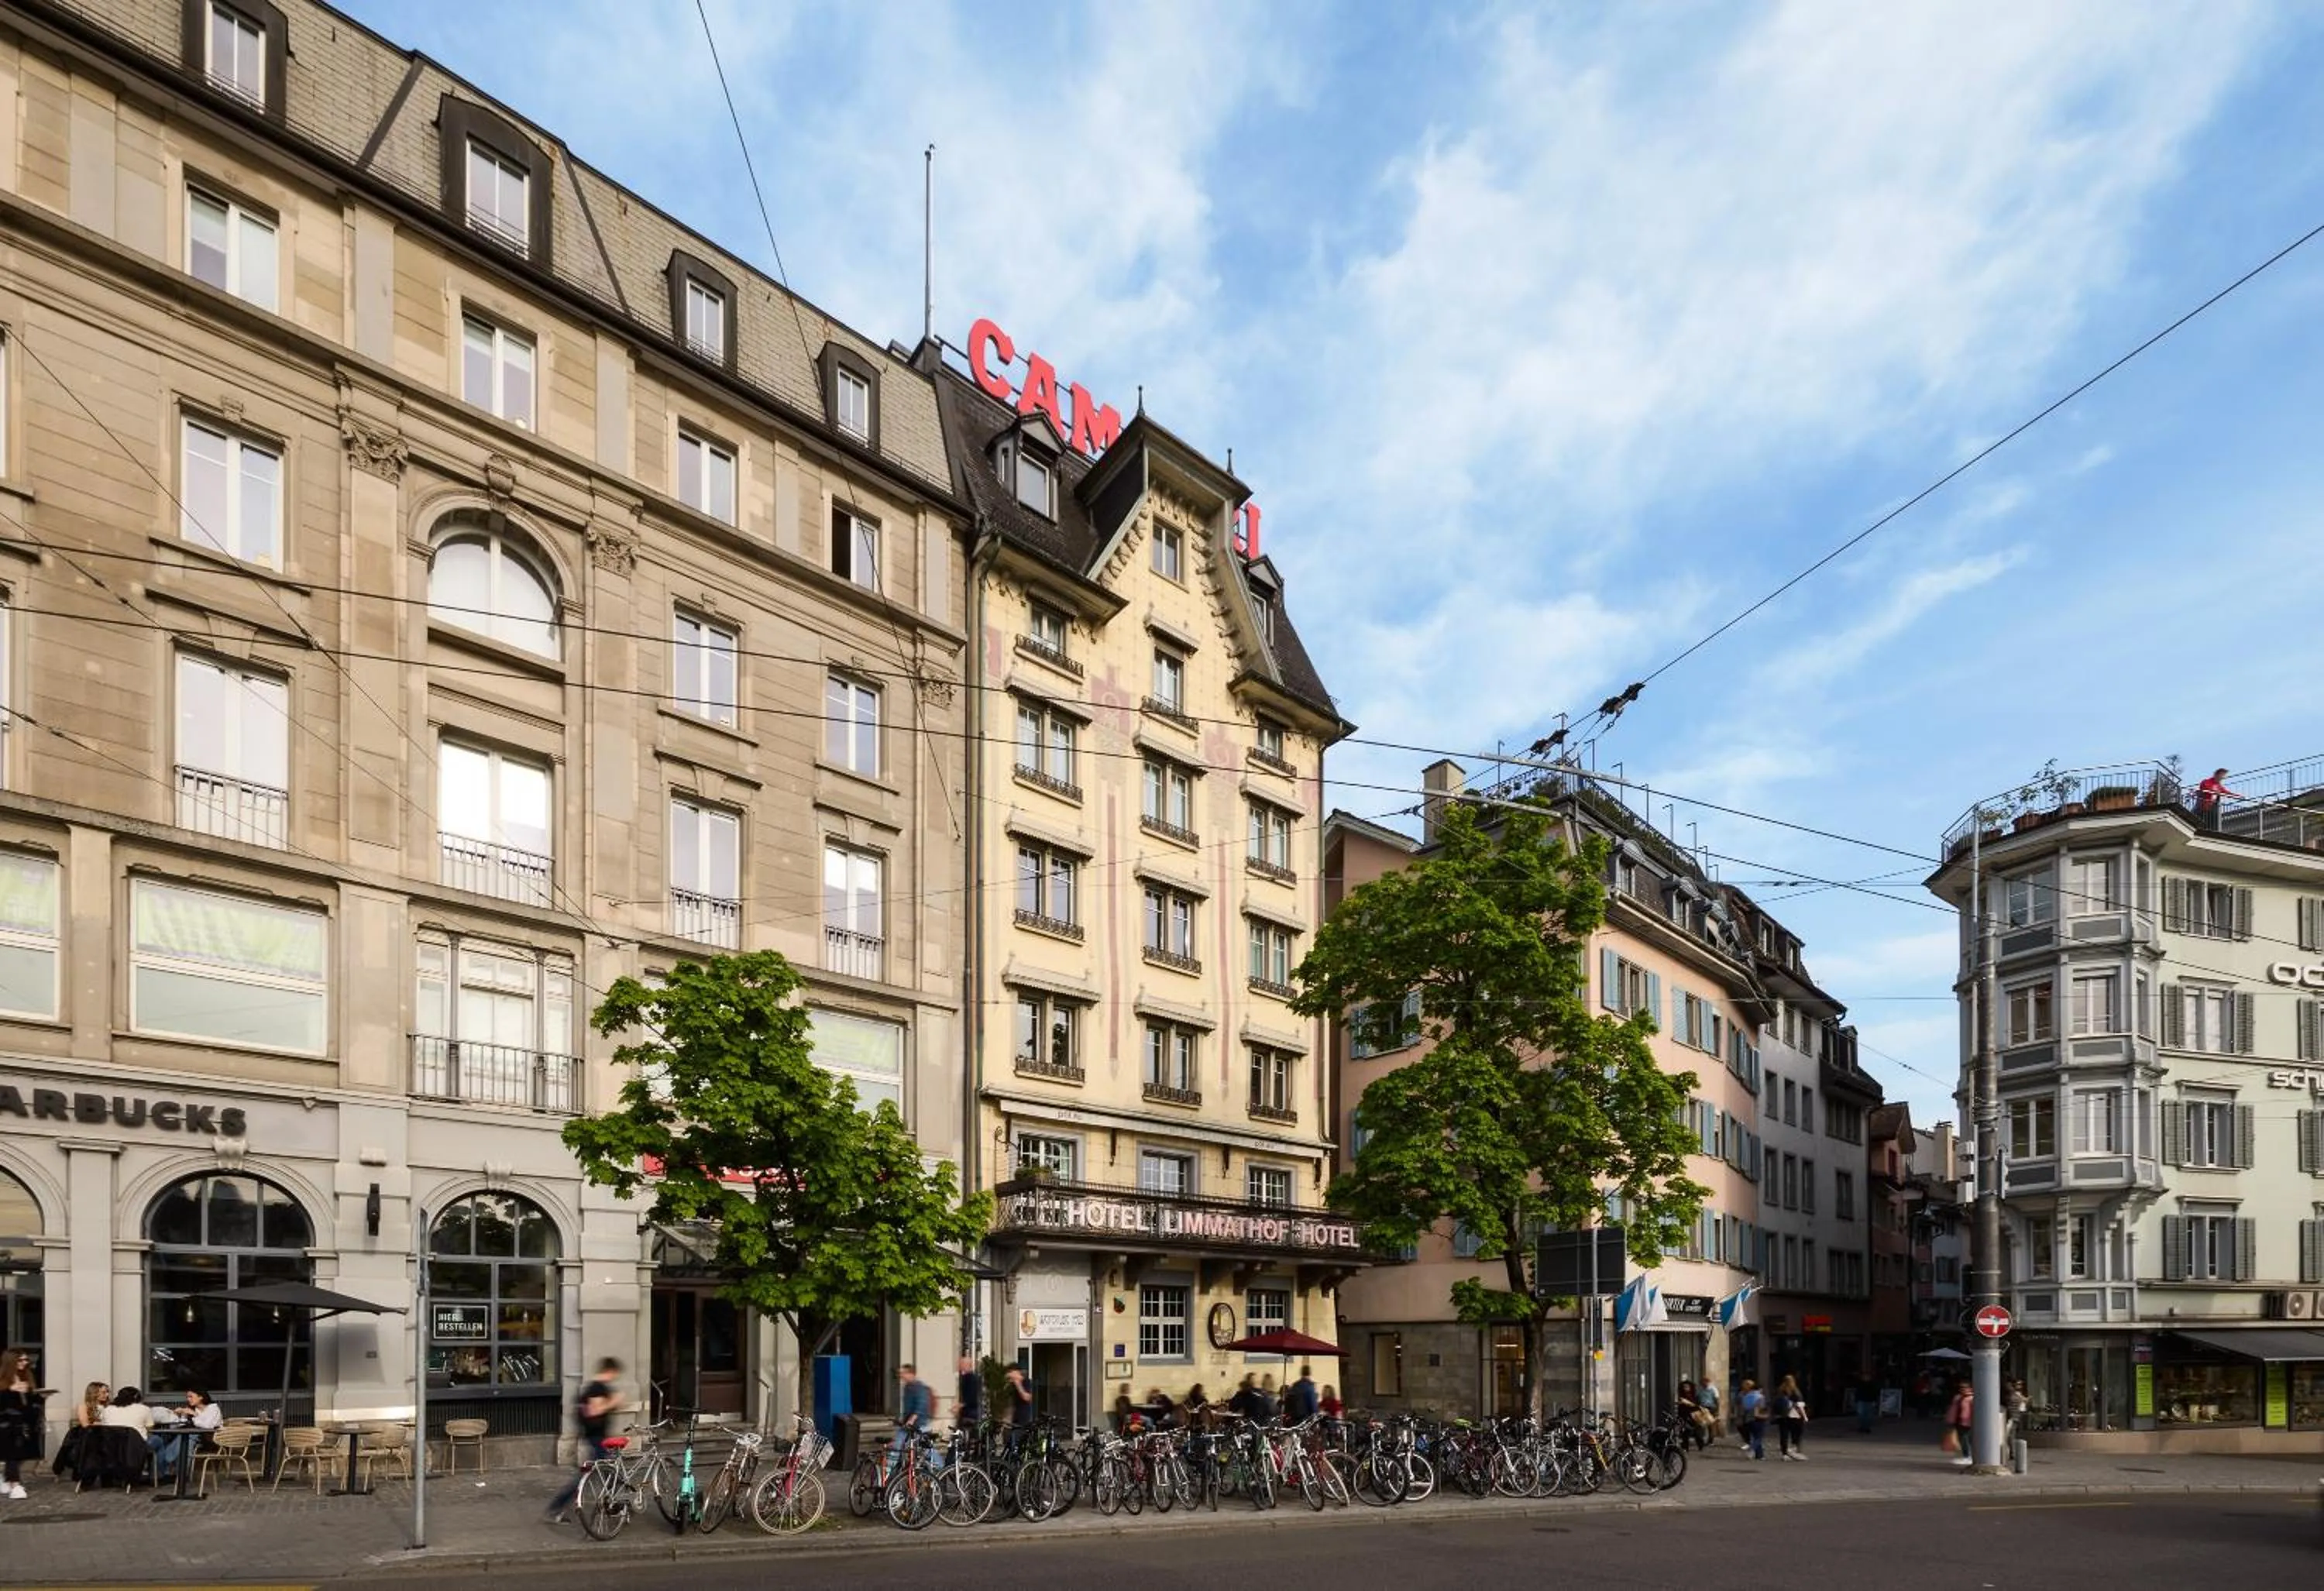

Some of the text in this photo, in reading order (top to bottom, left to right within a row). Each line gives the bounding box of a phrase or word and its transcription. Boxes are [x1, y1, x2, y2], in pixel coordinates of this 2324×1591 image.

[2267, 1069, 2324, 1091] sch
[0, 1085, 246, 1136] ARBUCKS
[1068, 1198, 1360, 1248] HOTEL LIMMATHOF HOTEL
